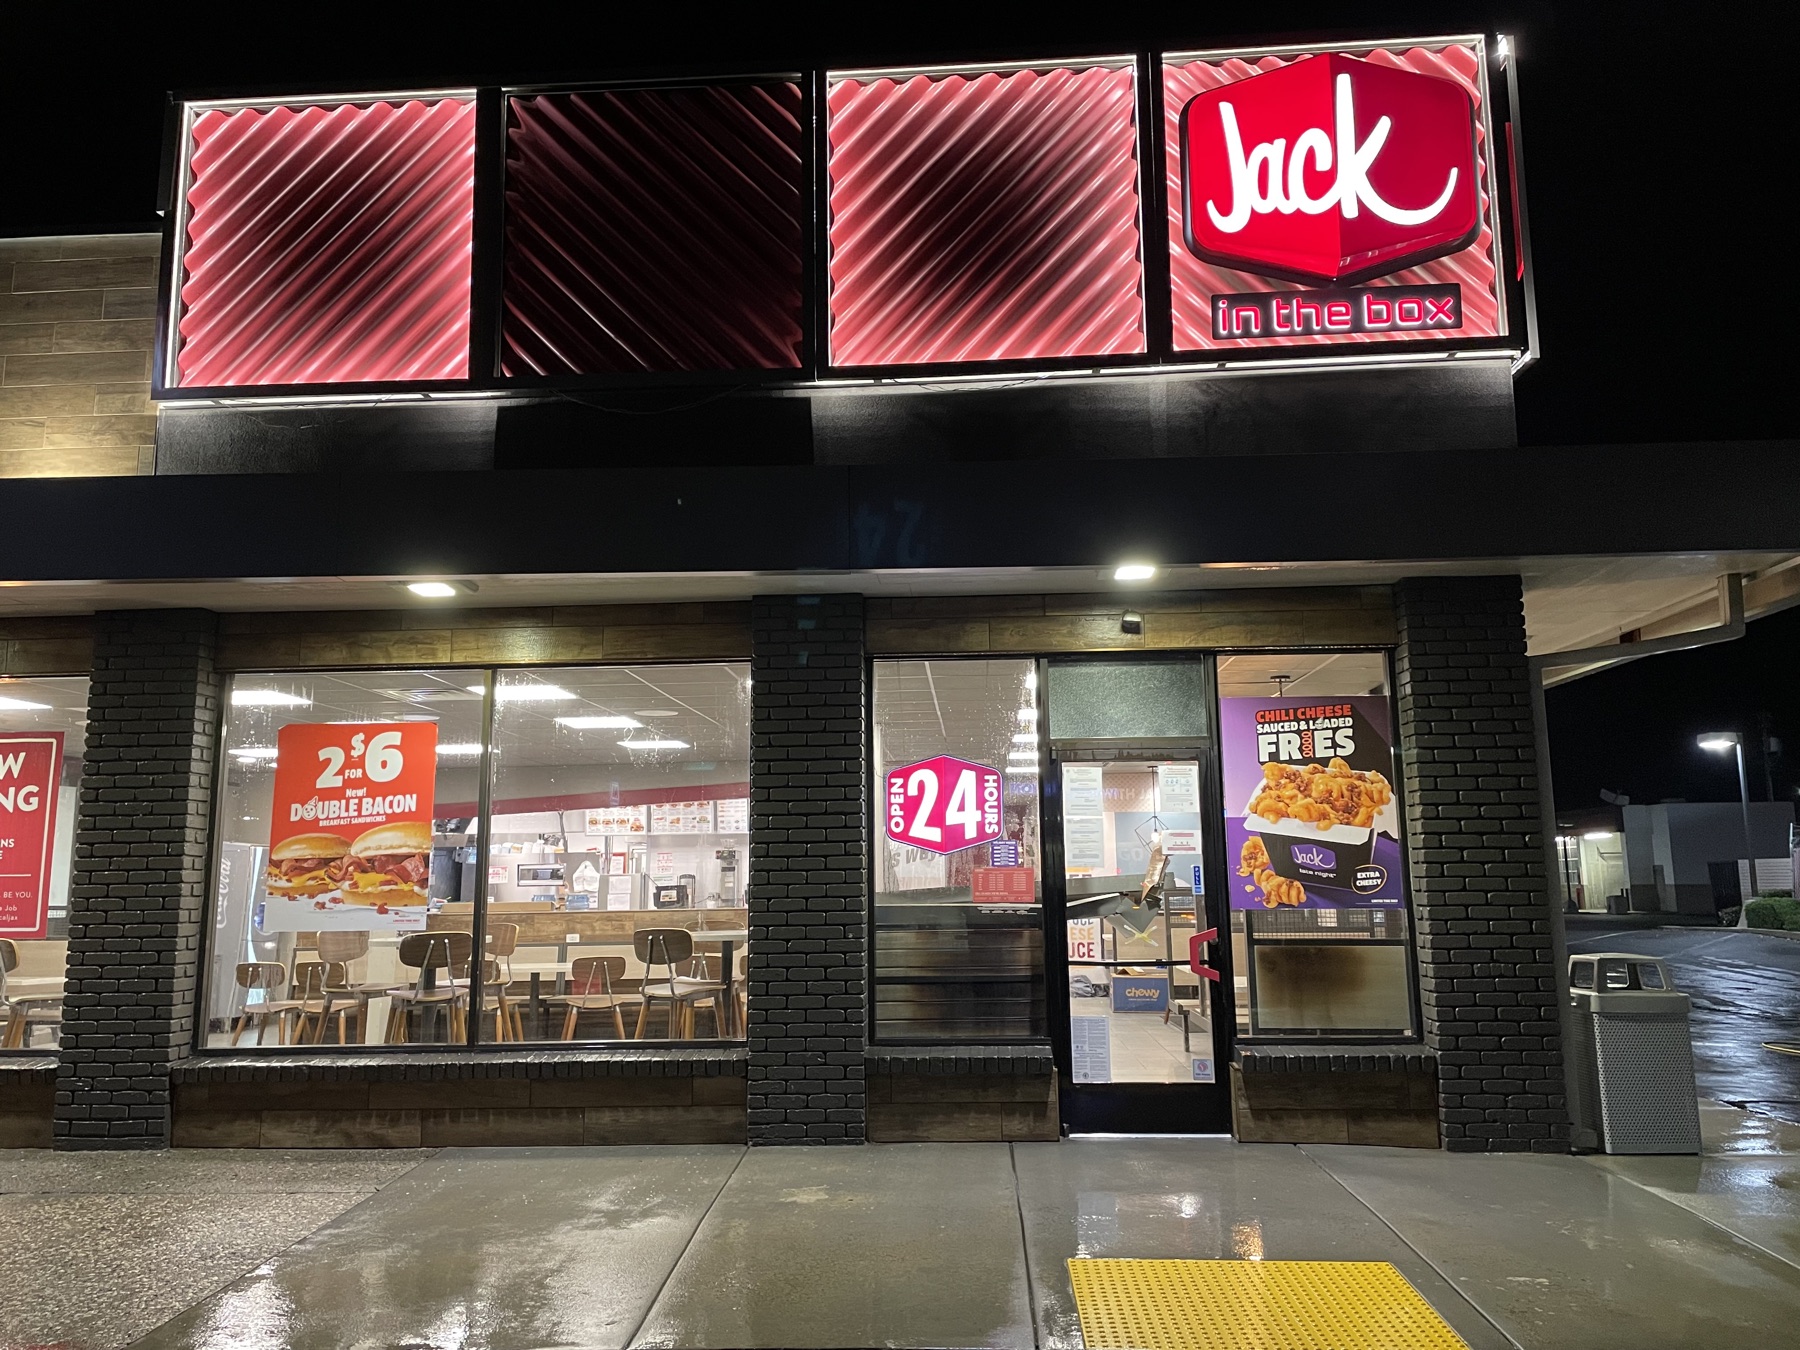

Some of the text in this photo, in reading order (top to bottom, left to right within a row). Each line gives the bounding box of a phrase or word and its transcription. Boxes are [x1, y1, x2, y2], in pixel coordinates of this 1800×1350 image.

[1206, 73, 1459, 233] Jack
[1218, 294, 1454, 333] in the box
[1256, 704, 1352, 722] CHILI CHEESE
[1256, 721, 1298, 734] SAUCED
[1299, 721, 1308, 731] &
[315, 746, 345, 789] 2
[344, 768, 363, 780] FOR
[345, 787, 367, 798] New!
[361, 794, 417, 816] BACON
[890, 777, 904, 833] OPEN
[907, 768, 982, 842] 24
[984, 775, 999, 834] HOURS
[319, 815, 386, 827] BREAKFAST SANDWICHES
[1294, 846, 1335, 868] Jack
[1356, 871, 1381, 879] EXTRA
[1356, 878, 1382, 887] CHEESY
[15, 891, 33, 899] YOU.
[4, 904, 18, 912] Job
[1125, 987, 1160, 999] chewy
